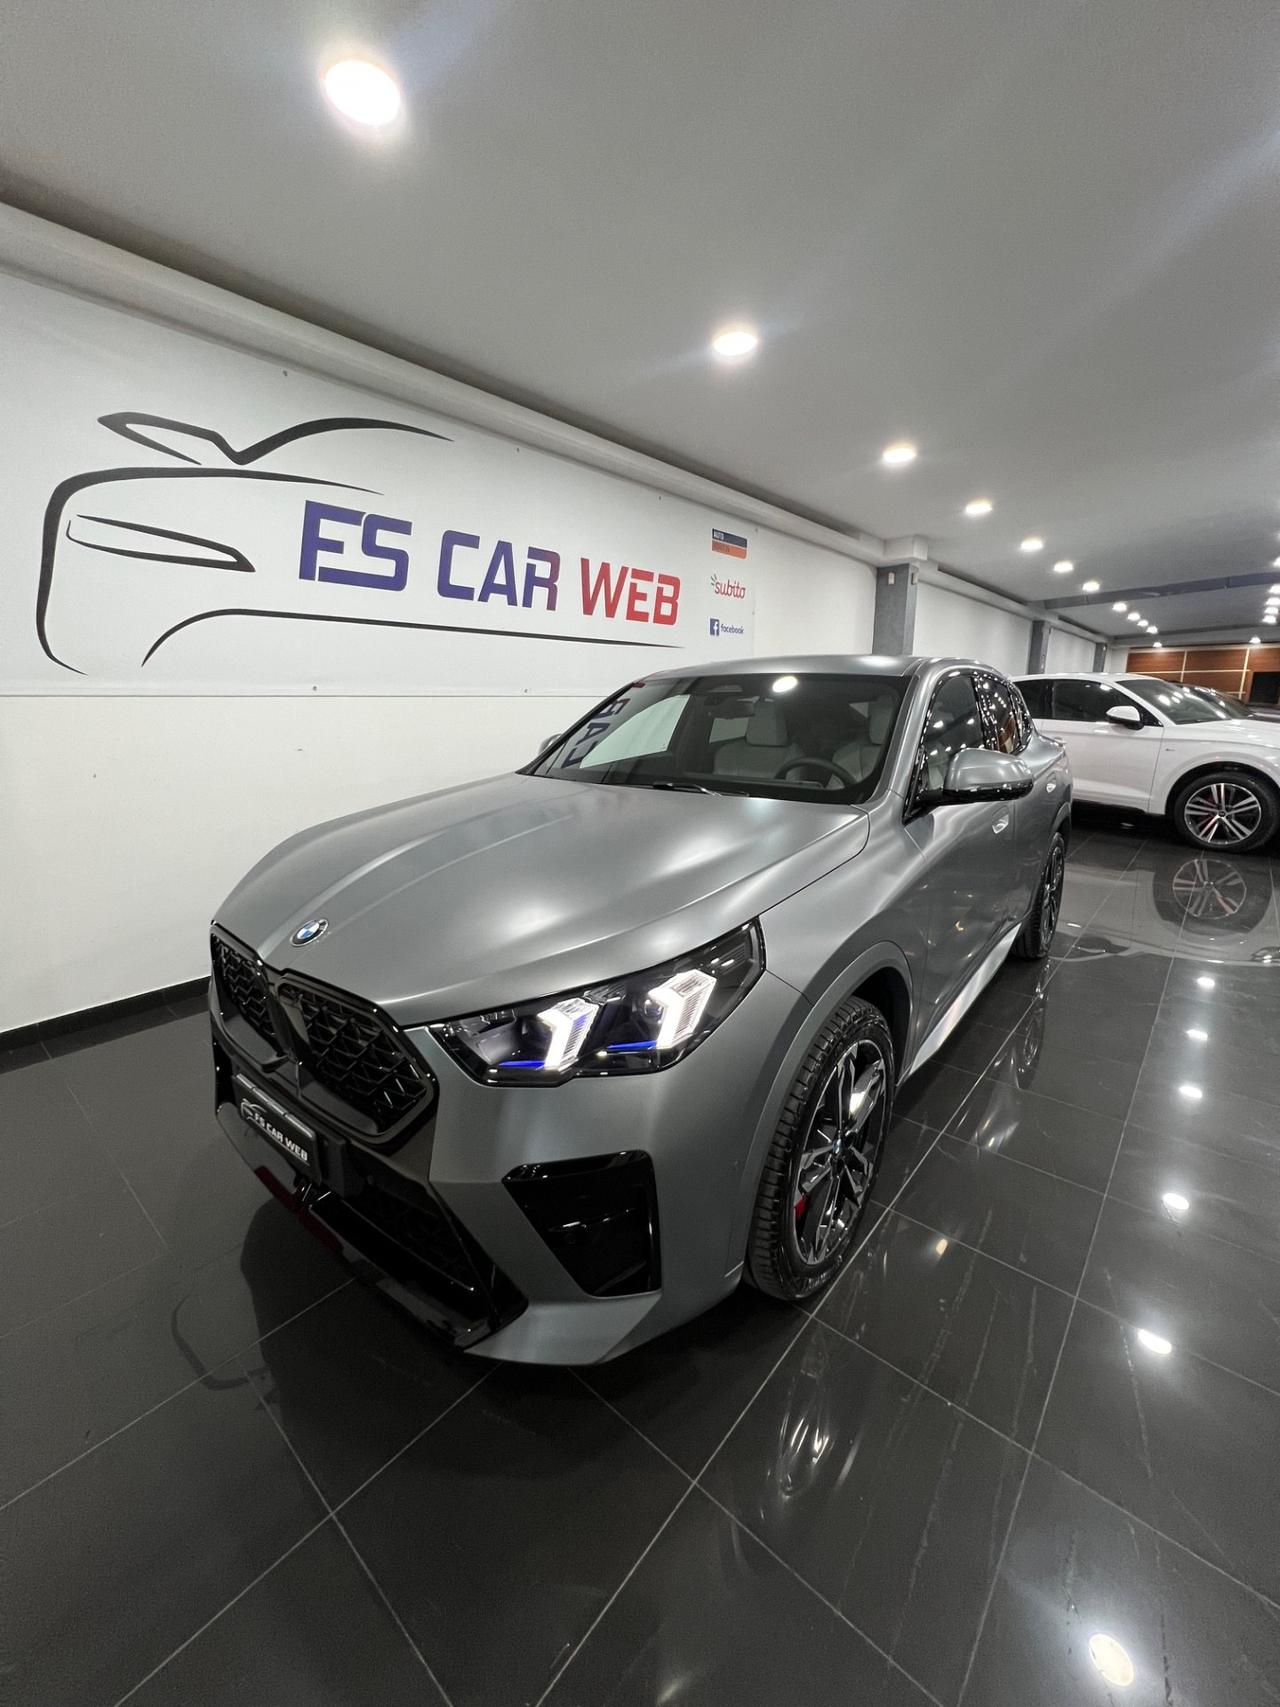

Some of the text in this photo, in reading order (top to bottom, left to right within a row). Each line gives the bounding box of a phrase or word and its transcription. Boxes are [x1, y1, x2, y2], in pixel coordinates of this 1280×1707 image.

[437, 530, 561, 611] CAR
[581, 557, 681, 626] WEB
[715, 579, 746, 599] subito
[720, 623, 744, 635] facebook
[266, 1122, 283, 1143] CAR
[284, 1136, 308, 1161] WEB
